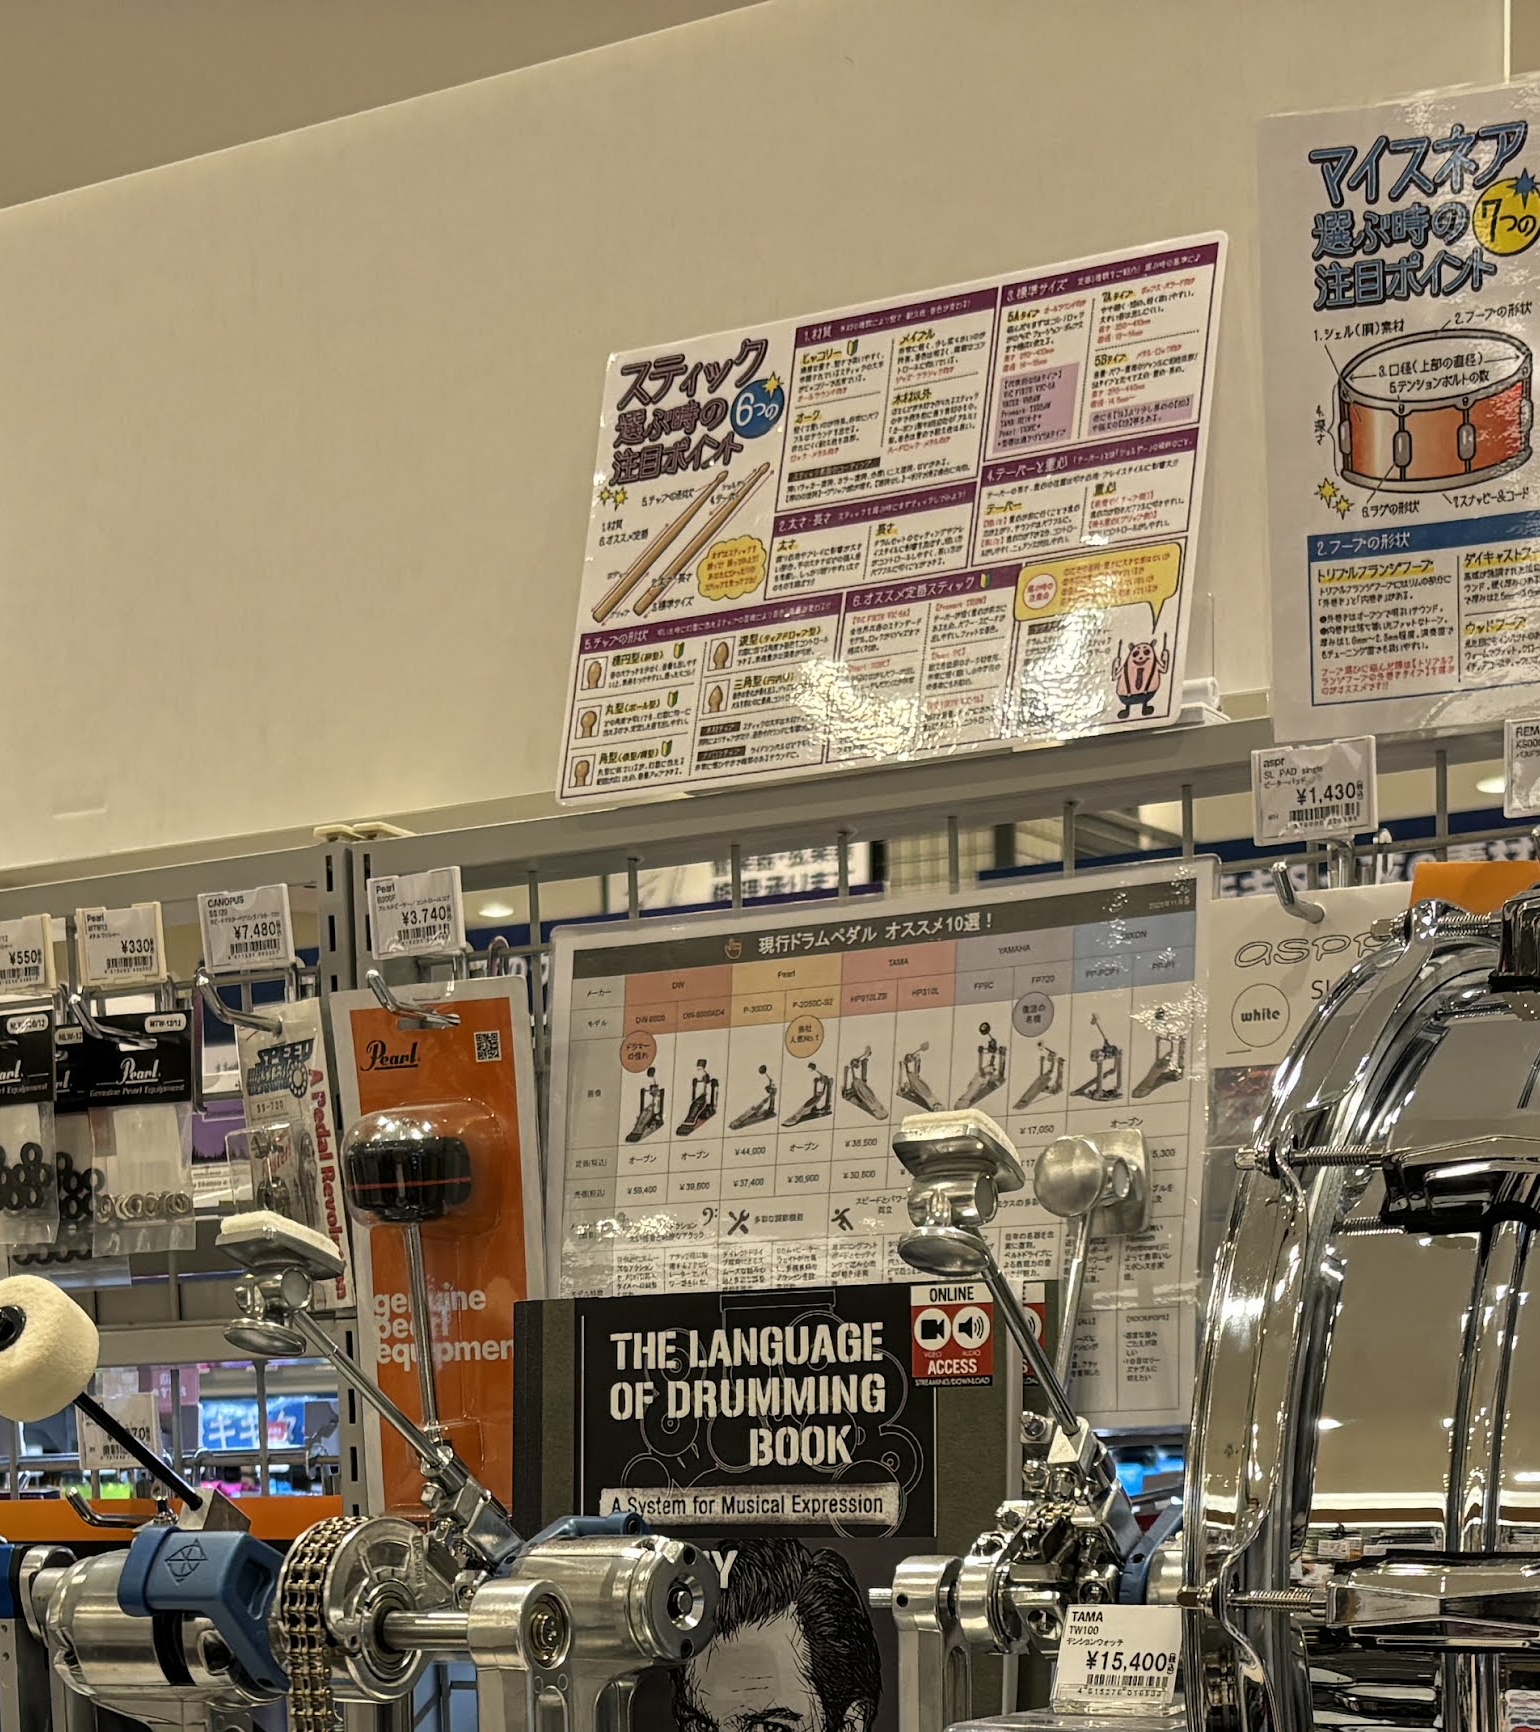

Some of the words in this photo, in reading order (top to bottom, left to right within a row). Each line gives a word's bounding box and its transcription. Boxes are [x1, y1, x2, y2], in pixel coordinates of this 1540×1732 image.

[1309, 121, 1528, 207] マイスネア
[1312, 202, 1469, 258] 選ぶ時の
[1482, 199, 1536, 242] 7つの
[1313, 247, 1497, 311] 注目ポイント
[617, 338, 768, 410] スティック
[613, 398, 729, 448] 選ぶ時の
[736, 393, 778, 426] 6つの
[609, 431, 743, 486] 注目ポイント
[1297, 782, 1355, 806] ¥1,430
[376, 885, 396, 894] Pearl
[758, 924, 878, 957] 現行ドラムペダル
[1238, 1005, 1280, 1025] white
[361, 1040, 421, 1071] Pearl
[929, 1287, 975, 1303] ONLINE
[609, 1330, 677, 1370] THE
[689, 1321, 884, 1369] LANGUAGE
[927, 1358, 978, 1376] ACCESS
[609, 1380, 654, 1421] OF
[667, 1373, 886, 1419] DRUMMING
[749, 1424, 853, 1467] BOOK
[693, 1494, 715, 1515] for
[721, 1495, 786, 1515] Musical
[791, 1493, 883, 1516] Expression
[1069, 1624, 1100, 1636] TW100
[1071, 1610, 1104, 1626] TAMA
[1085, 1650, 1169, 1675] ¥15,400
